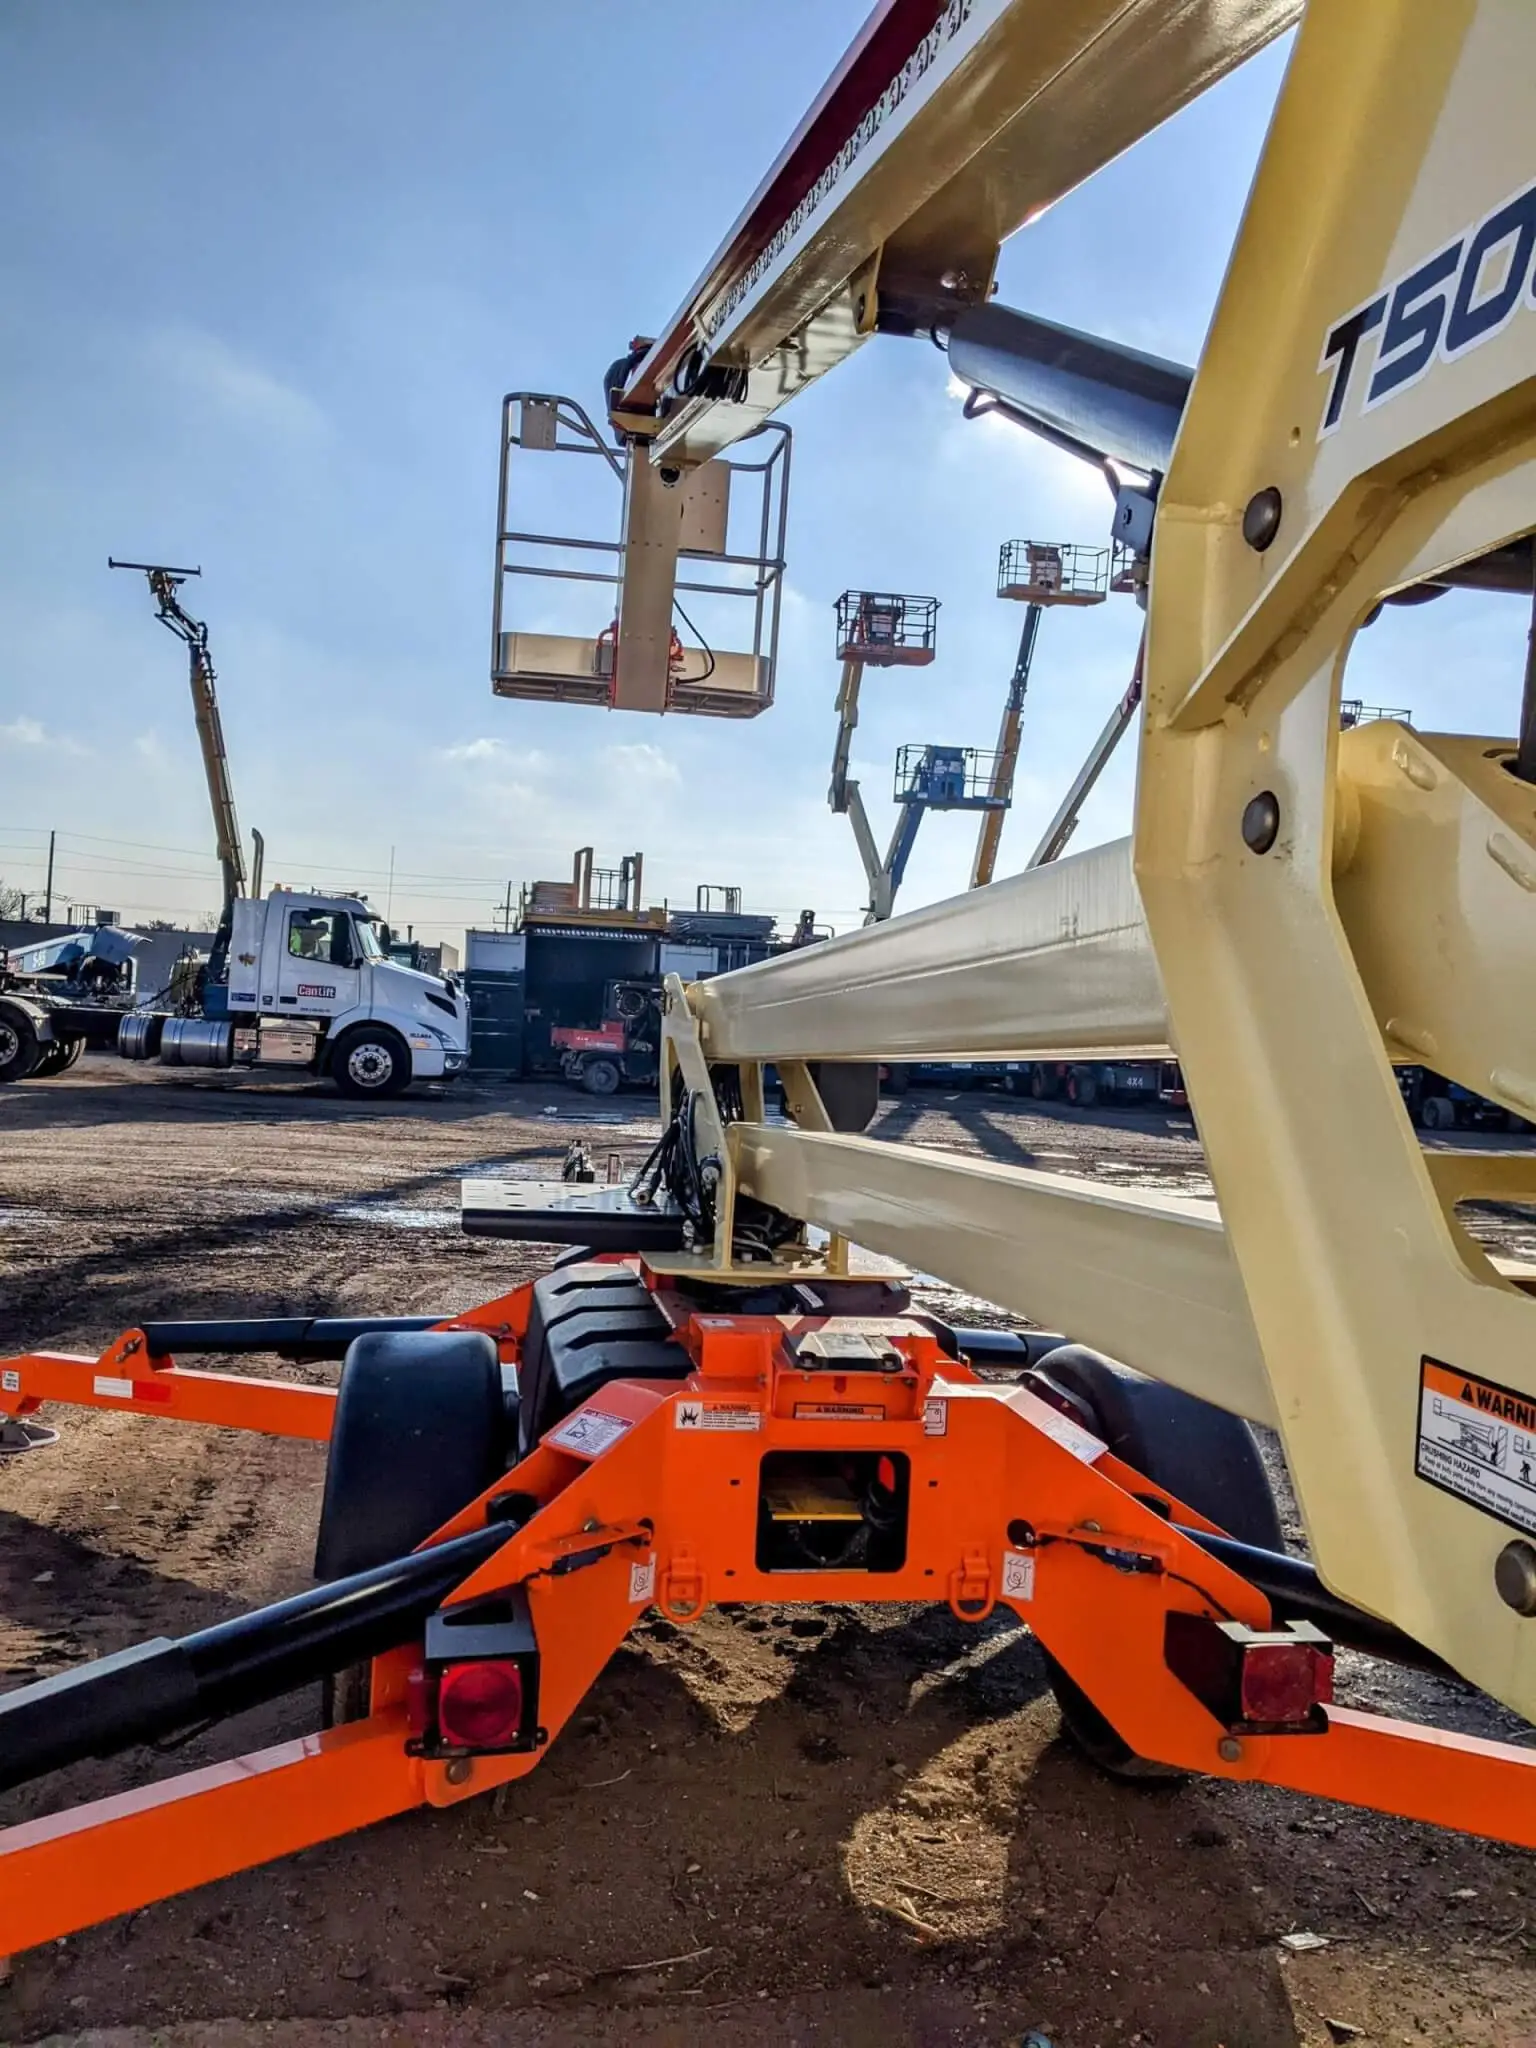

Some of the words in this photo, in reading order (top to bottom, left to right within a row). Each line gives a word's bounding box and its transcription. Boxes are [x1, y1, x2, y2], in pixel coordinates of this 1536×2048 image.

[1323, 185, 1536, 430] T50
[823, 1405, 865, 1414] WARNING
[1453, 1457, 1480, 1478] HAZARD
